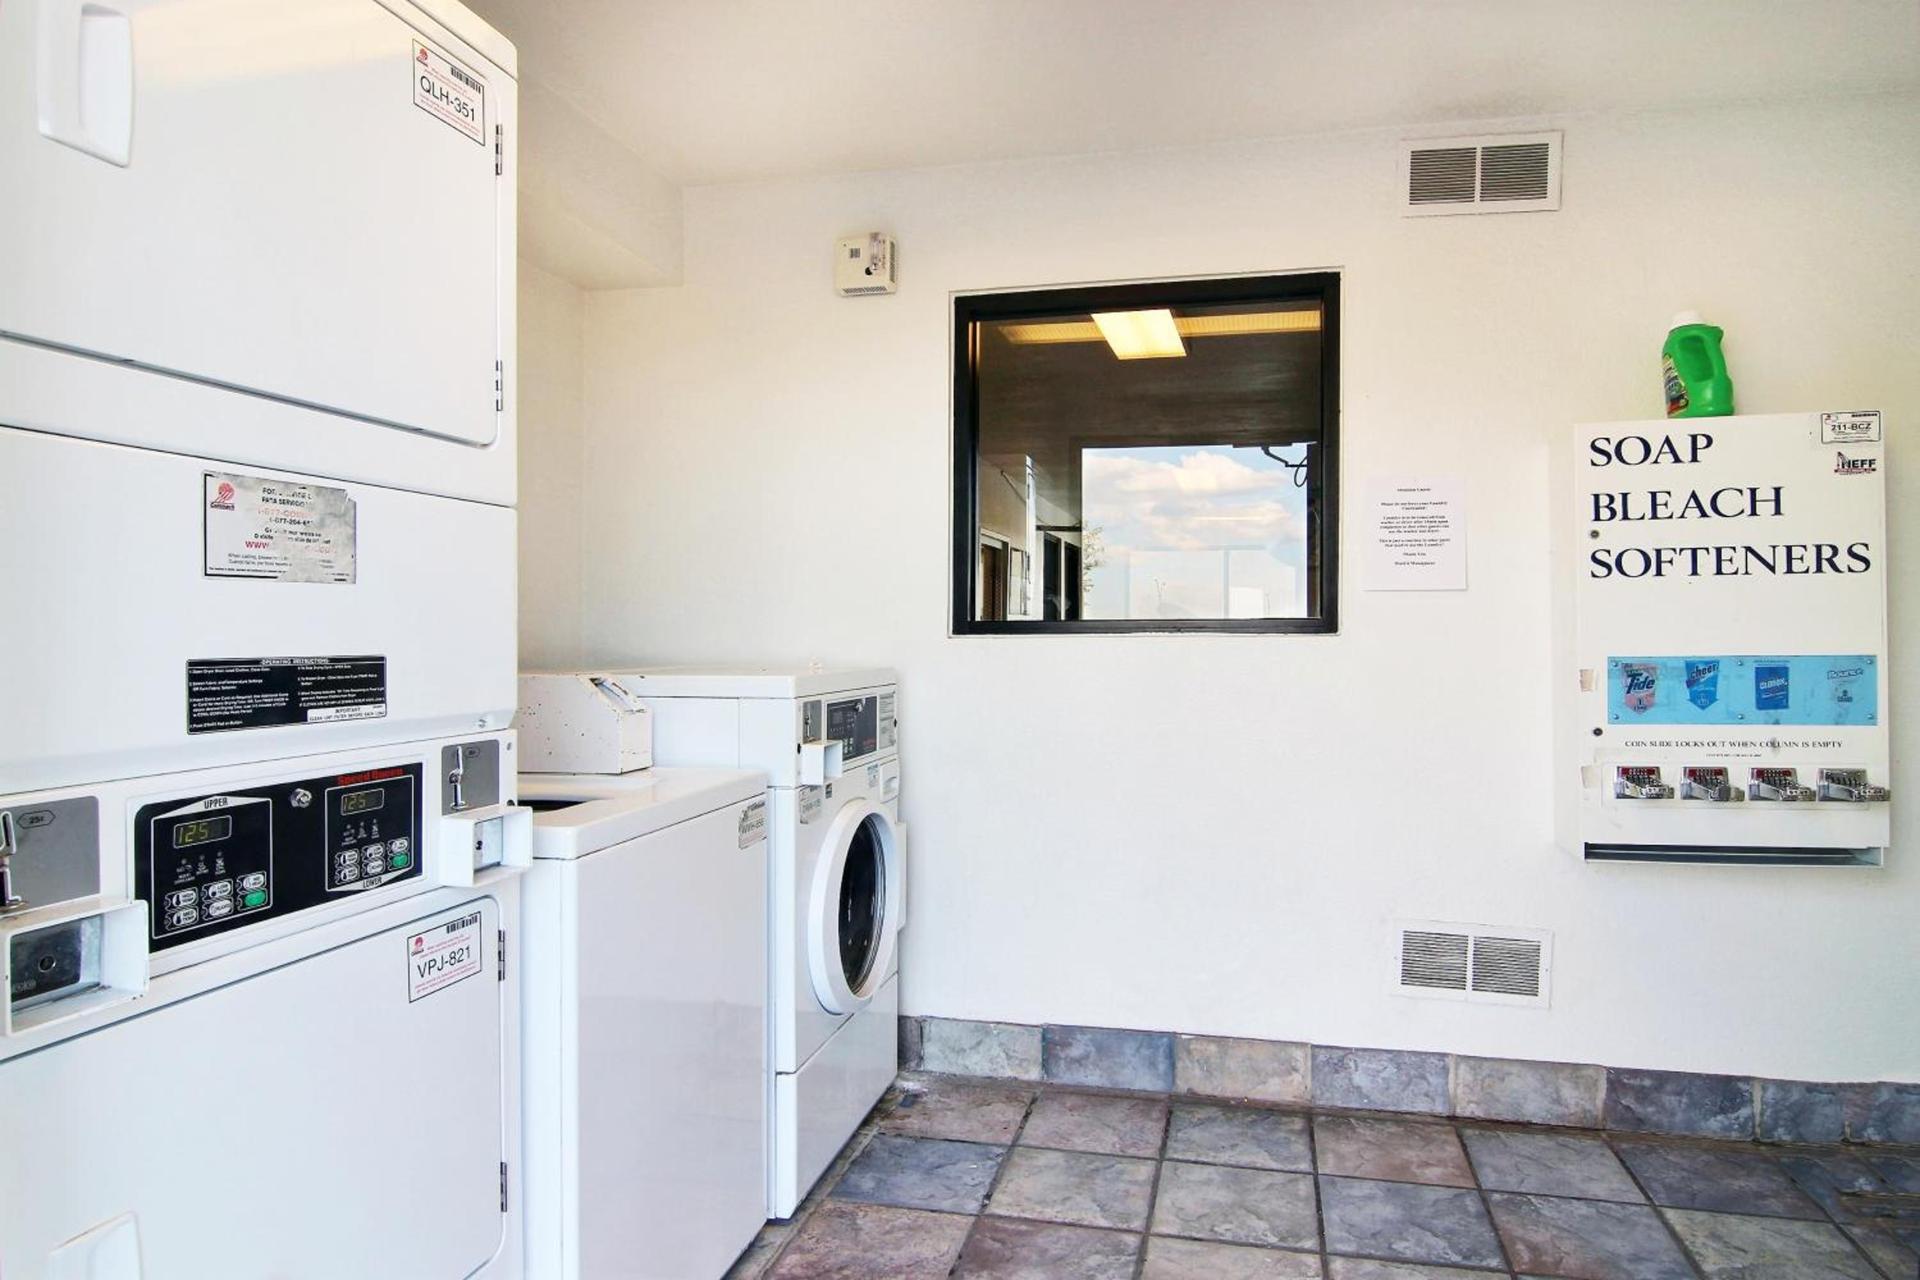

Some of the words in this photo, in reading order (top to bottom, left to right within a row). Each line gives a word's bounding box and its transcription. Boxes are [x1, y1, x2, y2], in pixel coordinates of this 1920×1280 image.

[420, 75, 475, 122] QLH-351
[1831, 423, 1872, 431] 211-BCZ
[1590, 433, 1714, 467] SOAP
[1591, 486, 1785, 522] BLEACH
[1590, 542, 1871, 579] SOFTENERS
[1728, 740, 1757, 748] WHEN
[1802, 740, 1810, 748] IS
[1812, 740, 1843, 748] EMPTY
[204, 797, 229, 809] UPPER
[363, 878, 383, 889] LOWER
[417, 945, 471, 978] VPJ-821
